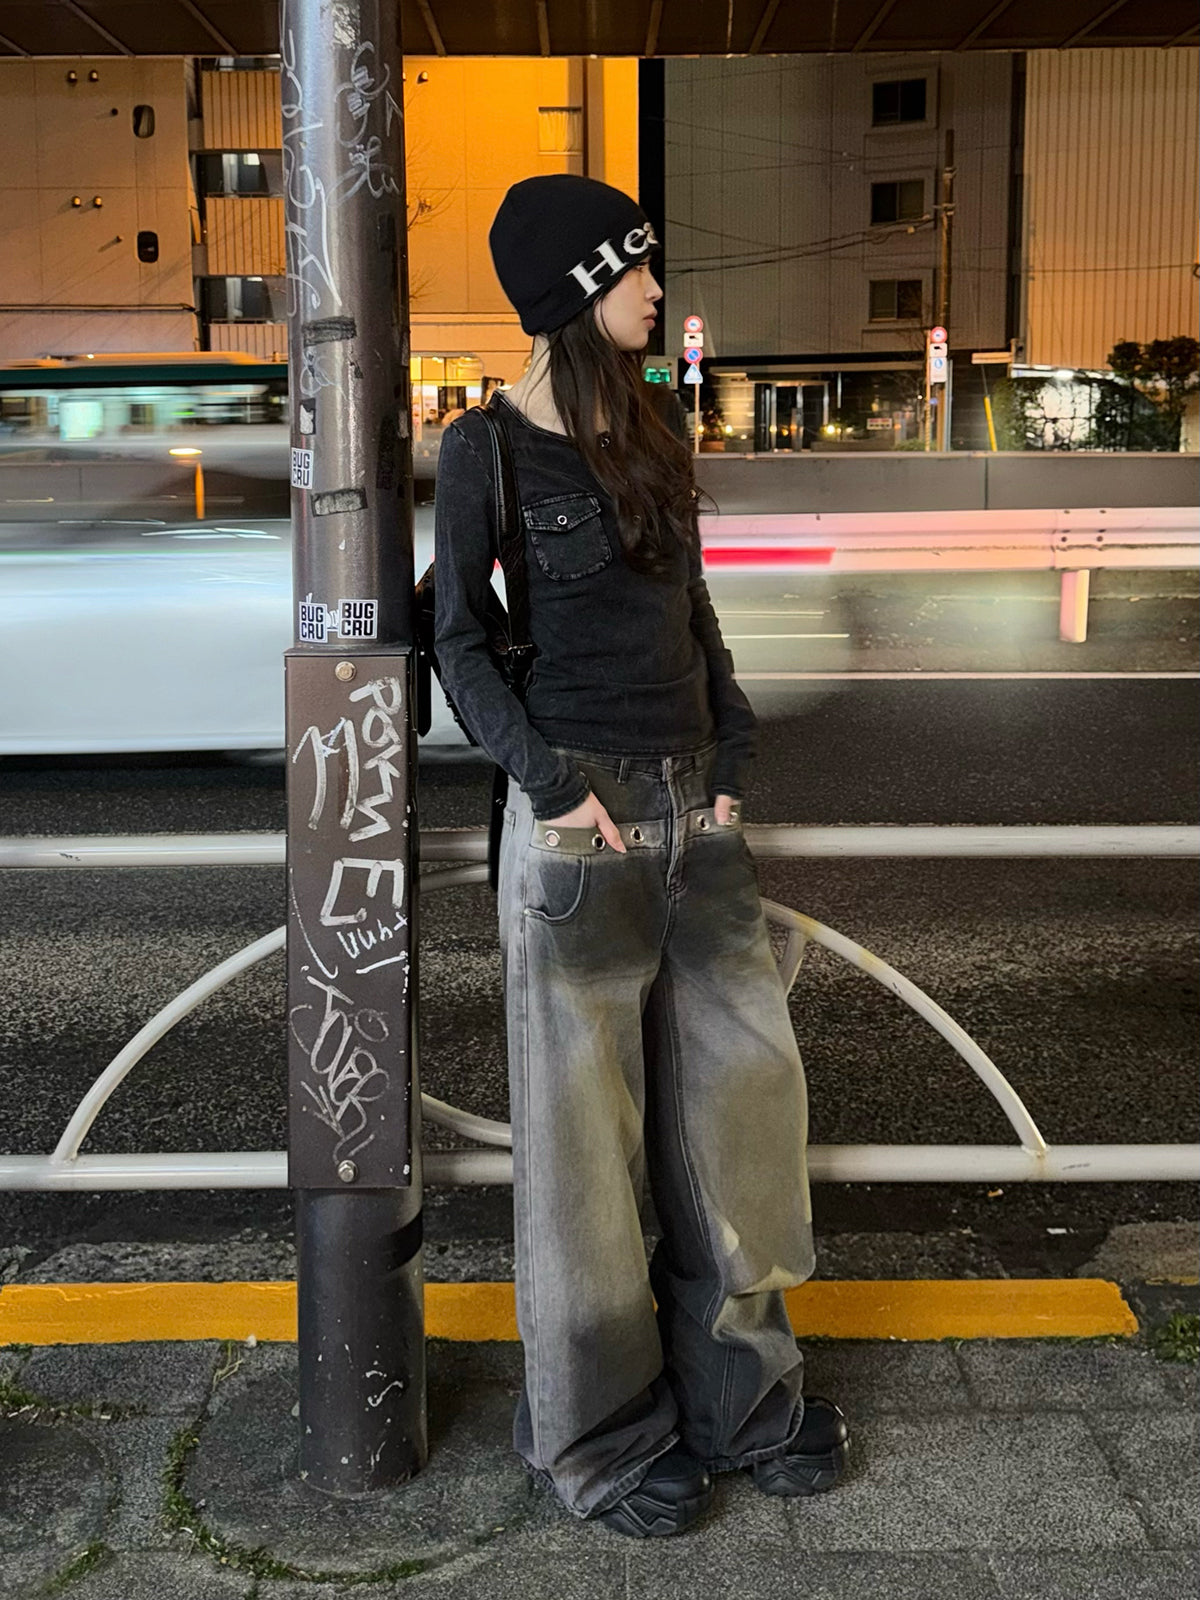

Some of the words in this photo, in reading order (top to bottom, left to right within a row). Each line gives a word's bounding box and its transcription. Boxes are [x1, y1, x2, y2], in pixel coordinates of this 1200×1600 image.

[293, 451, 310, 469] BUG
[293, 468, 310, 486] CRU
[301, 605, 324, 623] BUG
[341, 602, 374, 619] BUG
[301, 622, 324, 640] CRU
[341, 619, 374, 636] CRU
